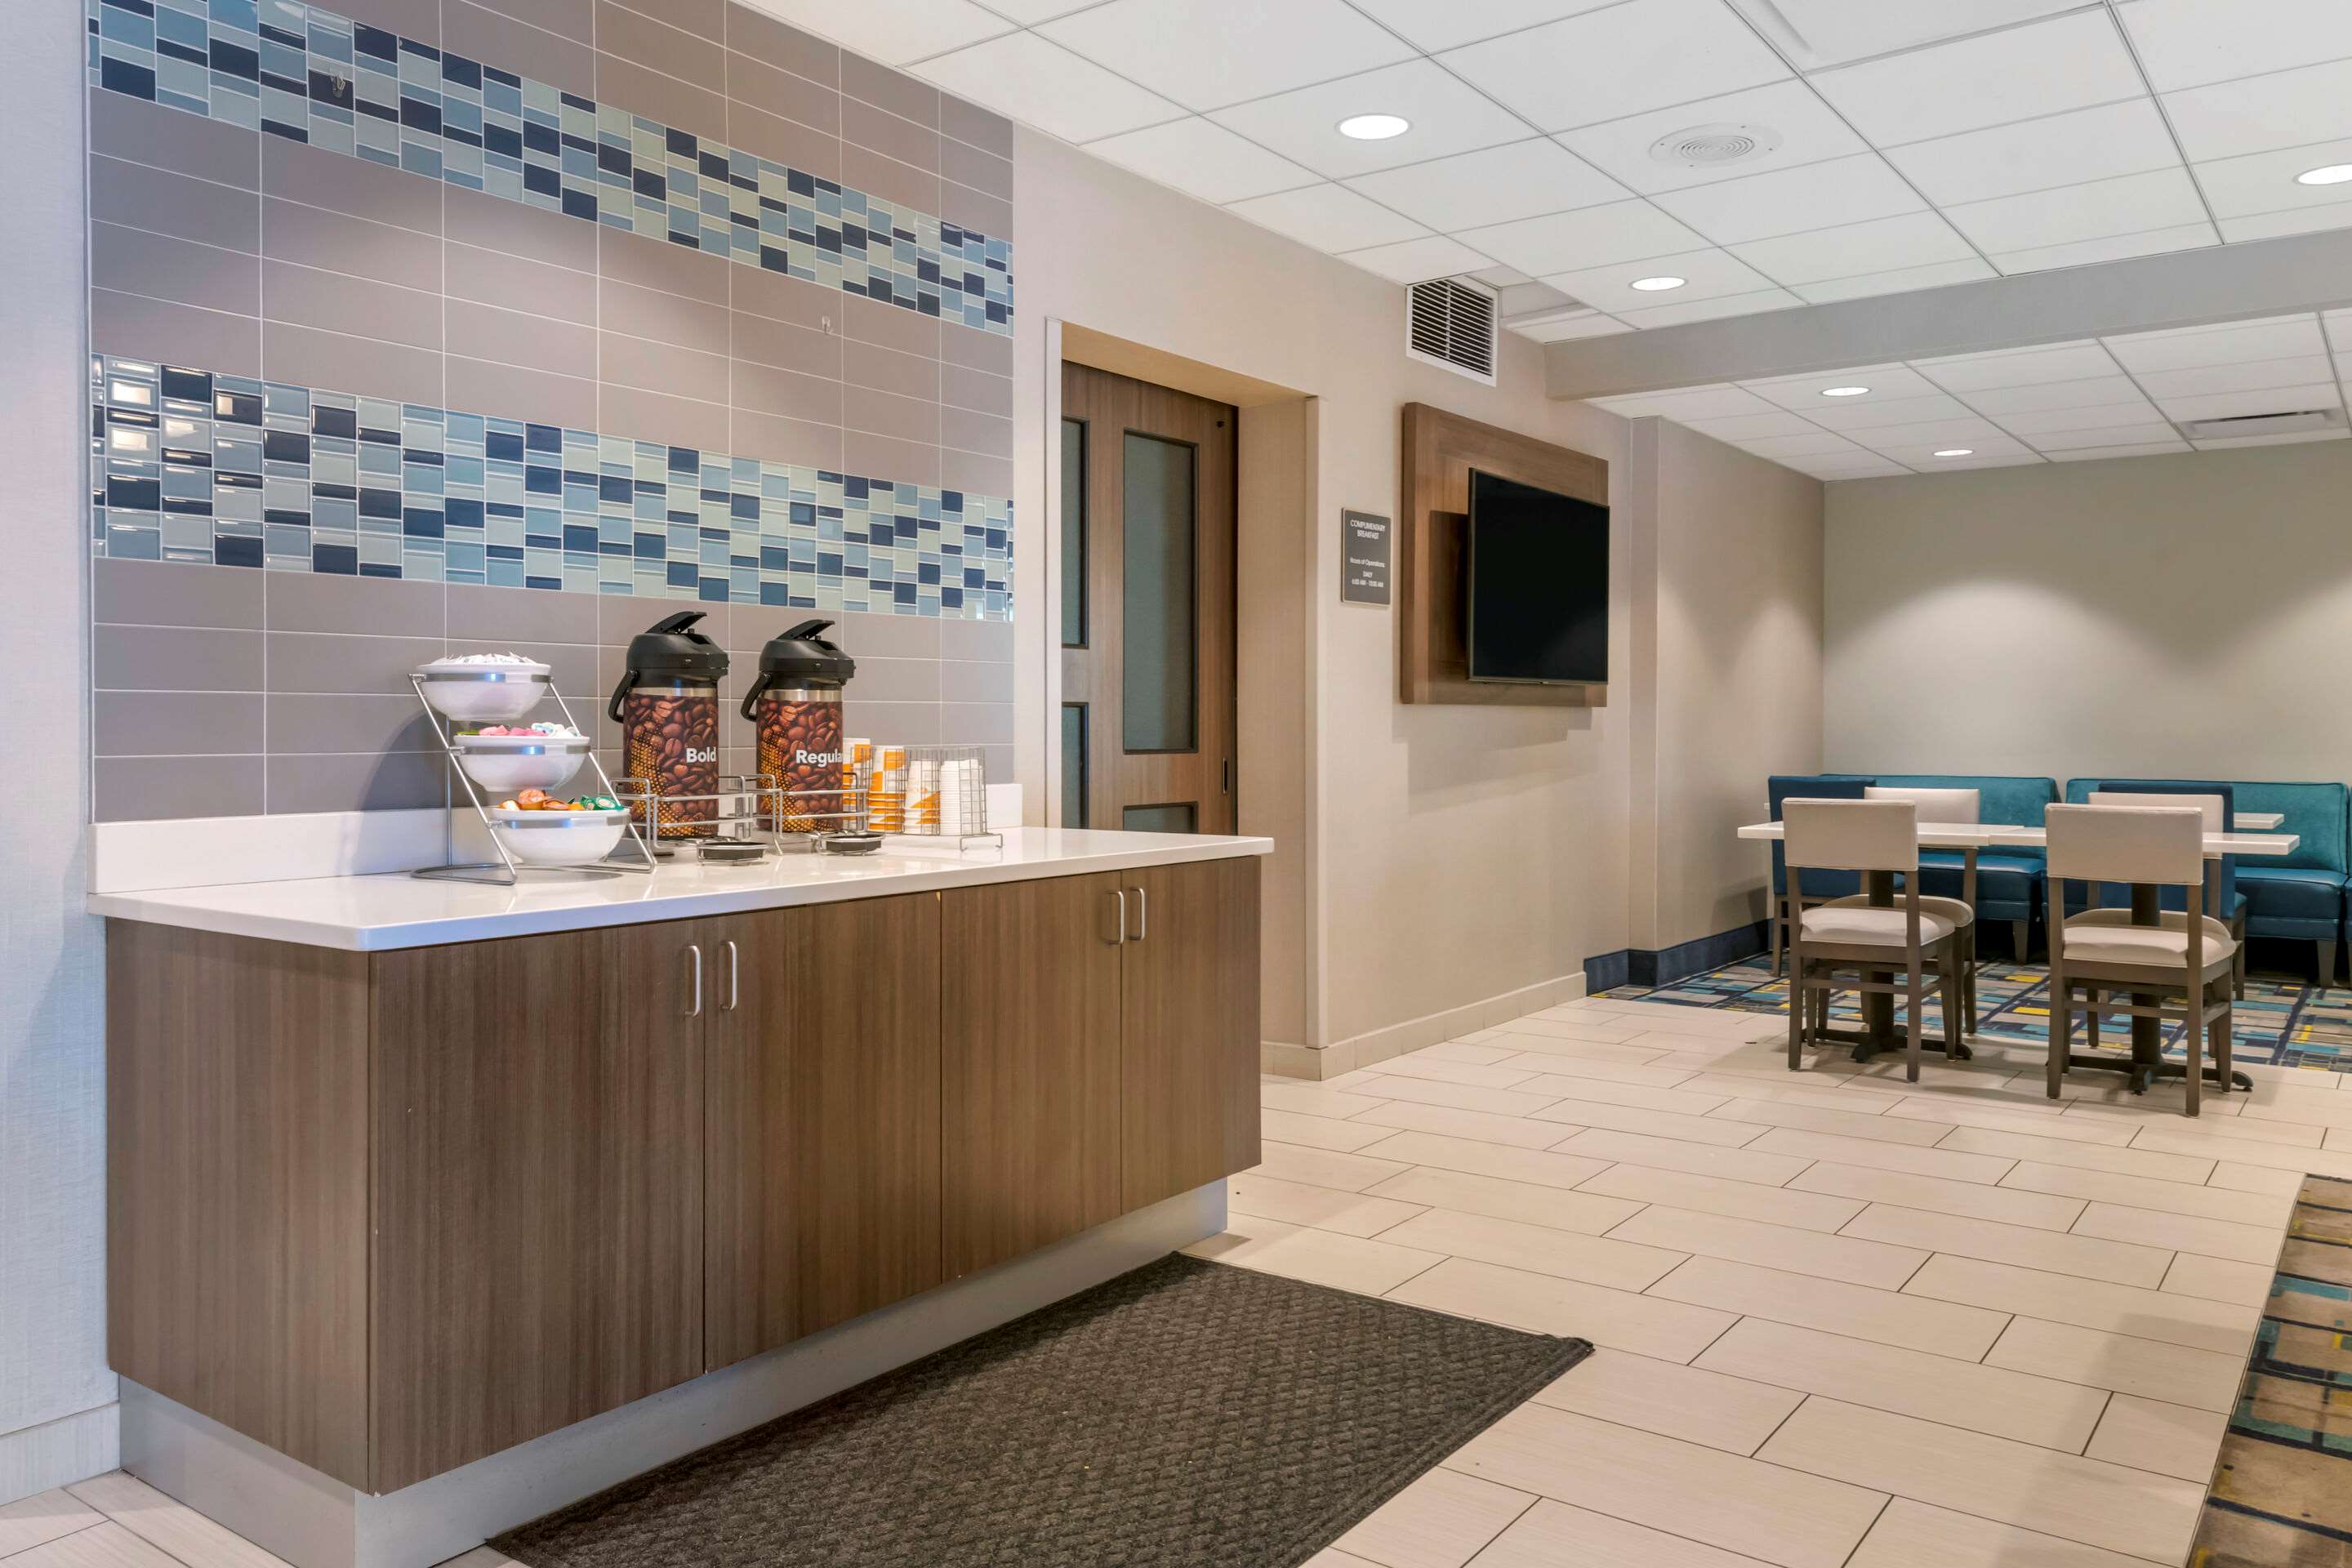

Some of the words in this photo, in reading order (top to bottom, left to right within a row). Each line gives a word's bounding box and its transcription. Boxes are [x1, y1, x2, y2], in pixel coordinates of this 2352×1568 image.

[1357, 529, 1379, 540] BREAKFAST
[686, 746, 716, 764] Bold
[795, 748, 843, 768] Regula
